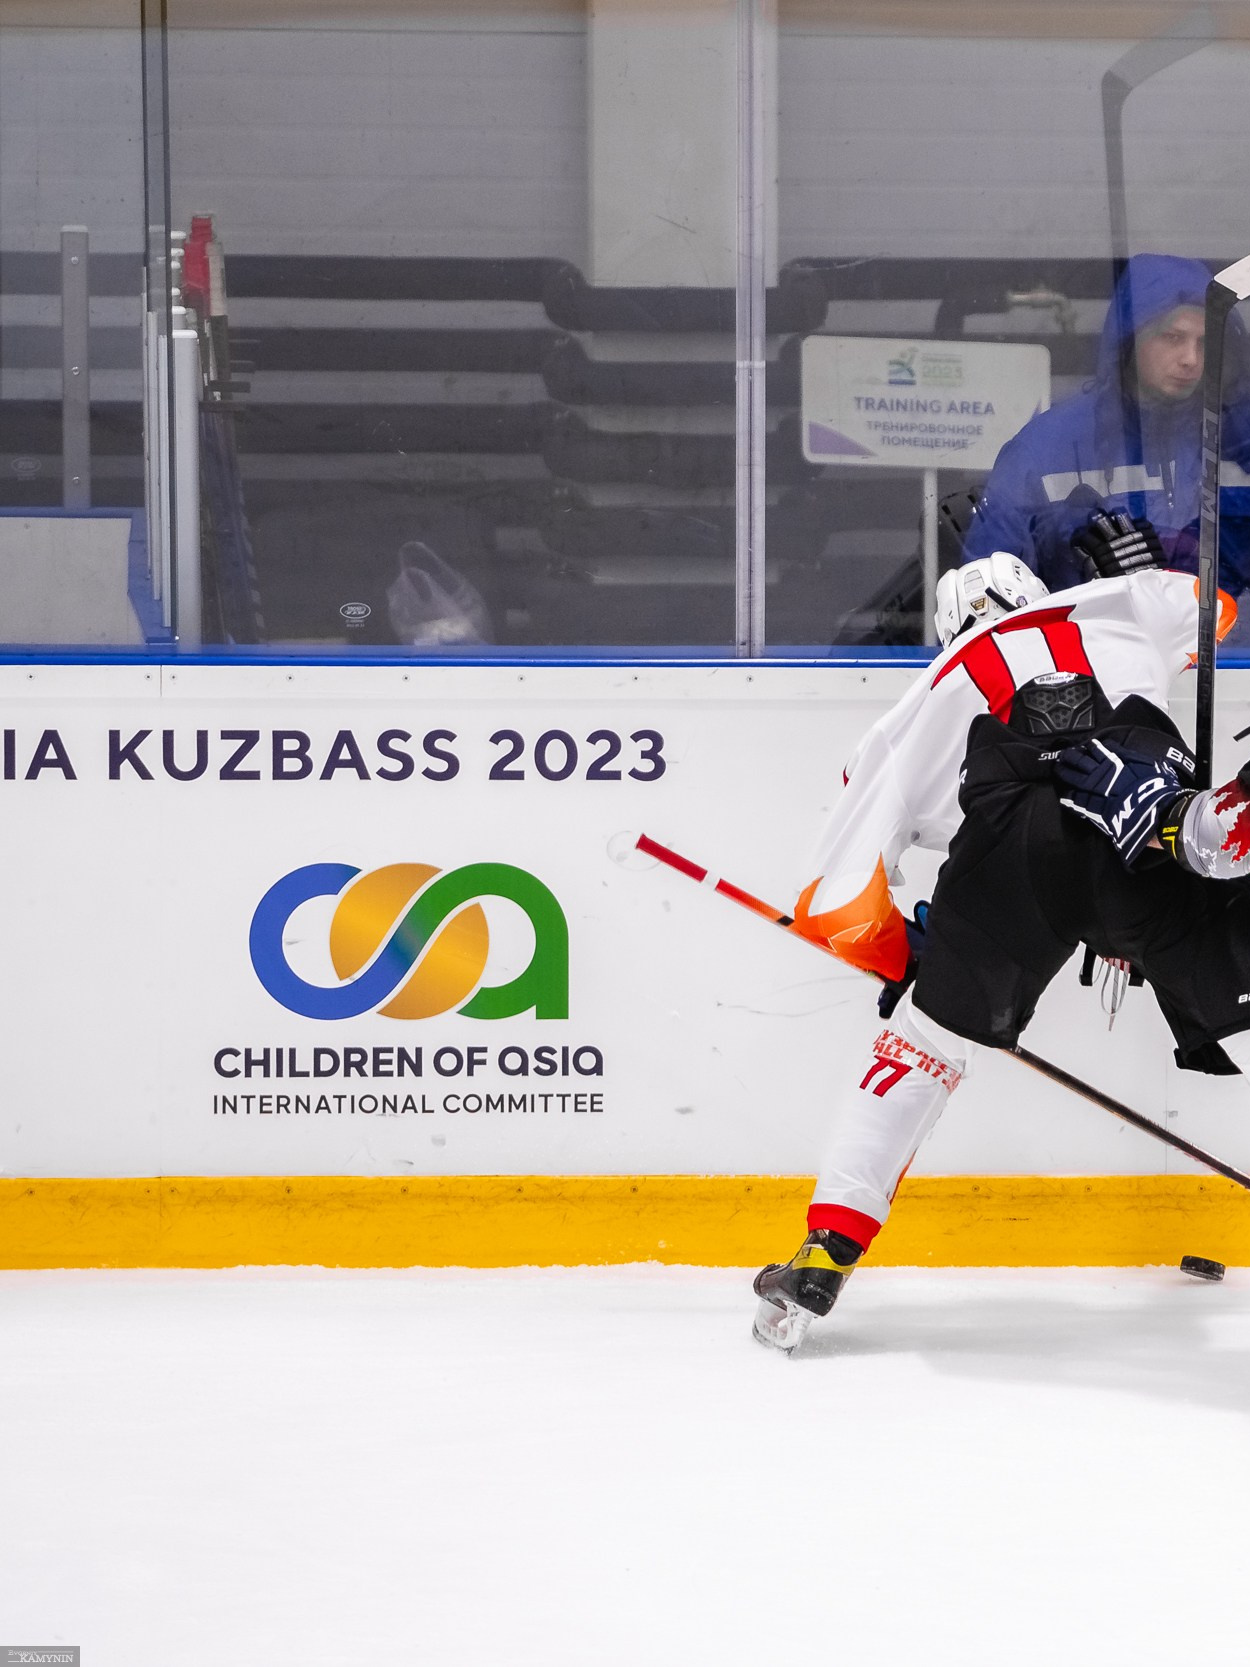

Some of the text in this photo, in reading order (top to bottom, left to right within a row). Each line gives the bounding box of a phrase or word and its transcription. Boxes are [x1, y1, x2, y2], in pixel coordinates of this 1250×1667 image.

[854, 396, 996, 415] TRAINING AREA
[866, 420, 984, 435] ТРЕНИРОВОЧНОЕ
[881, 434, 969, 449] ПОМЕЩЕНИЕ
[108, 730, 460, 782] KUZBASS
[488, 730, 667, 782] 2023
[213, 1046, 423, 1079] CHILDREN
[432, 1046, 489, 1079] OF
[859, 1054, 914, 1098] 77
[213, 1093, 604, 1115] INTERNATIONAL COMMITTEE
